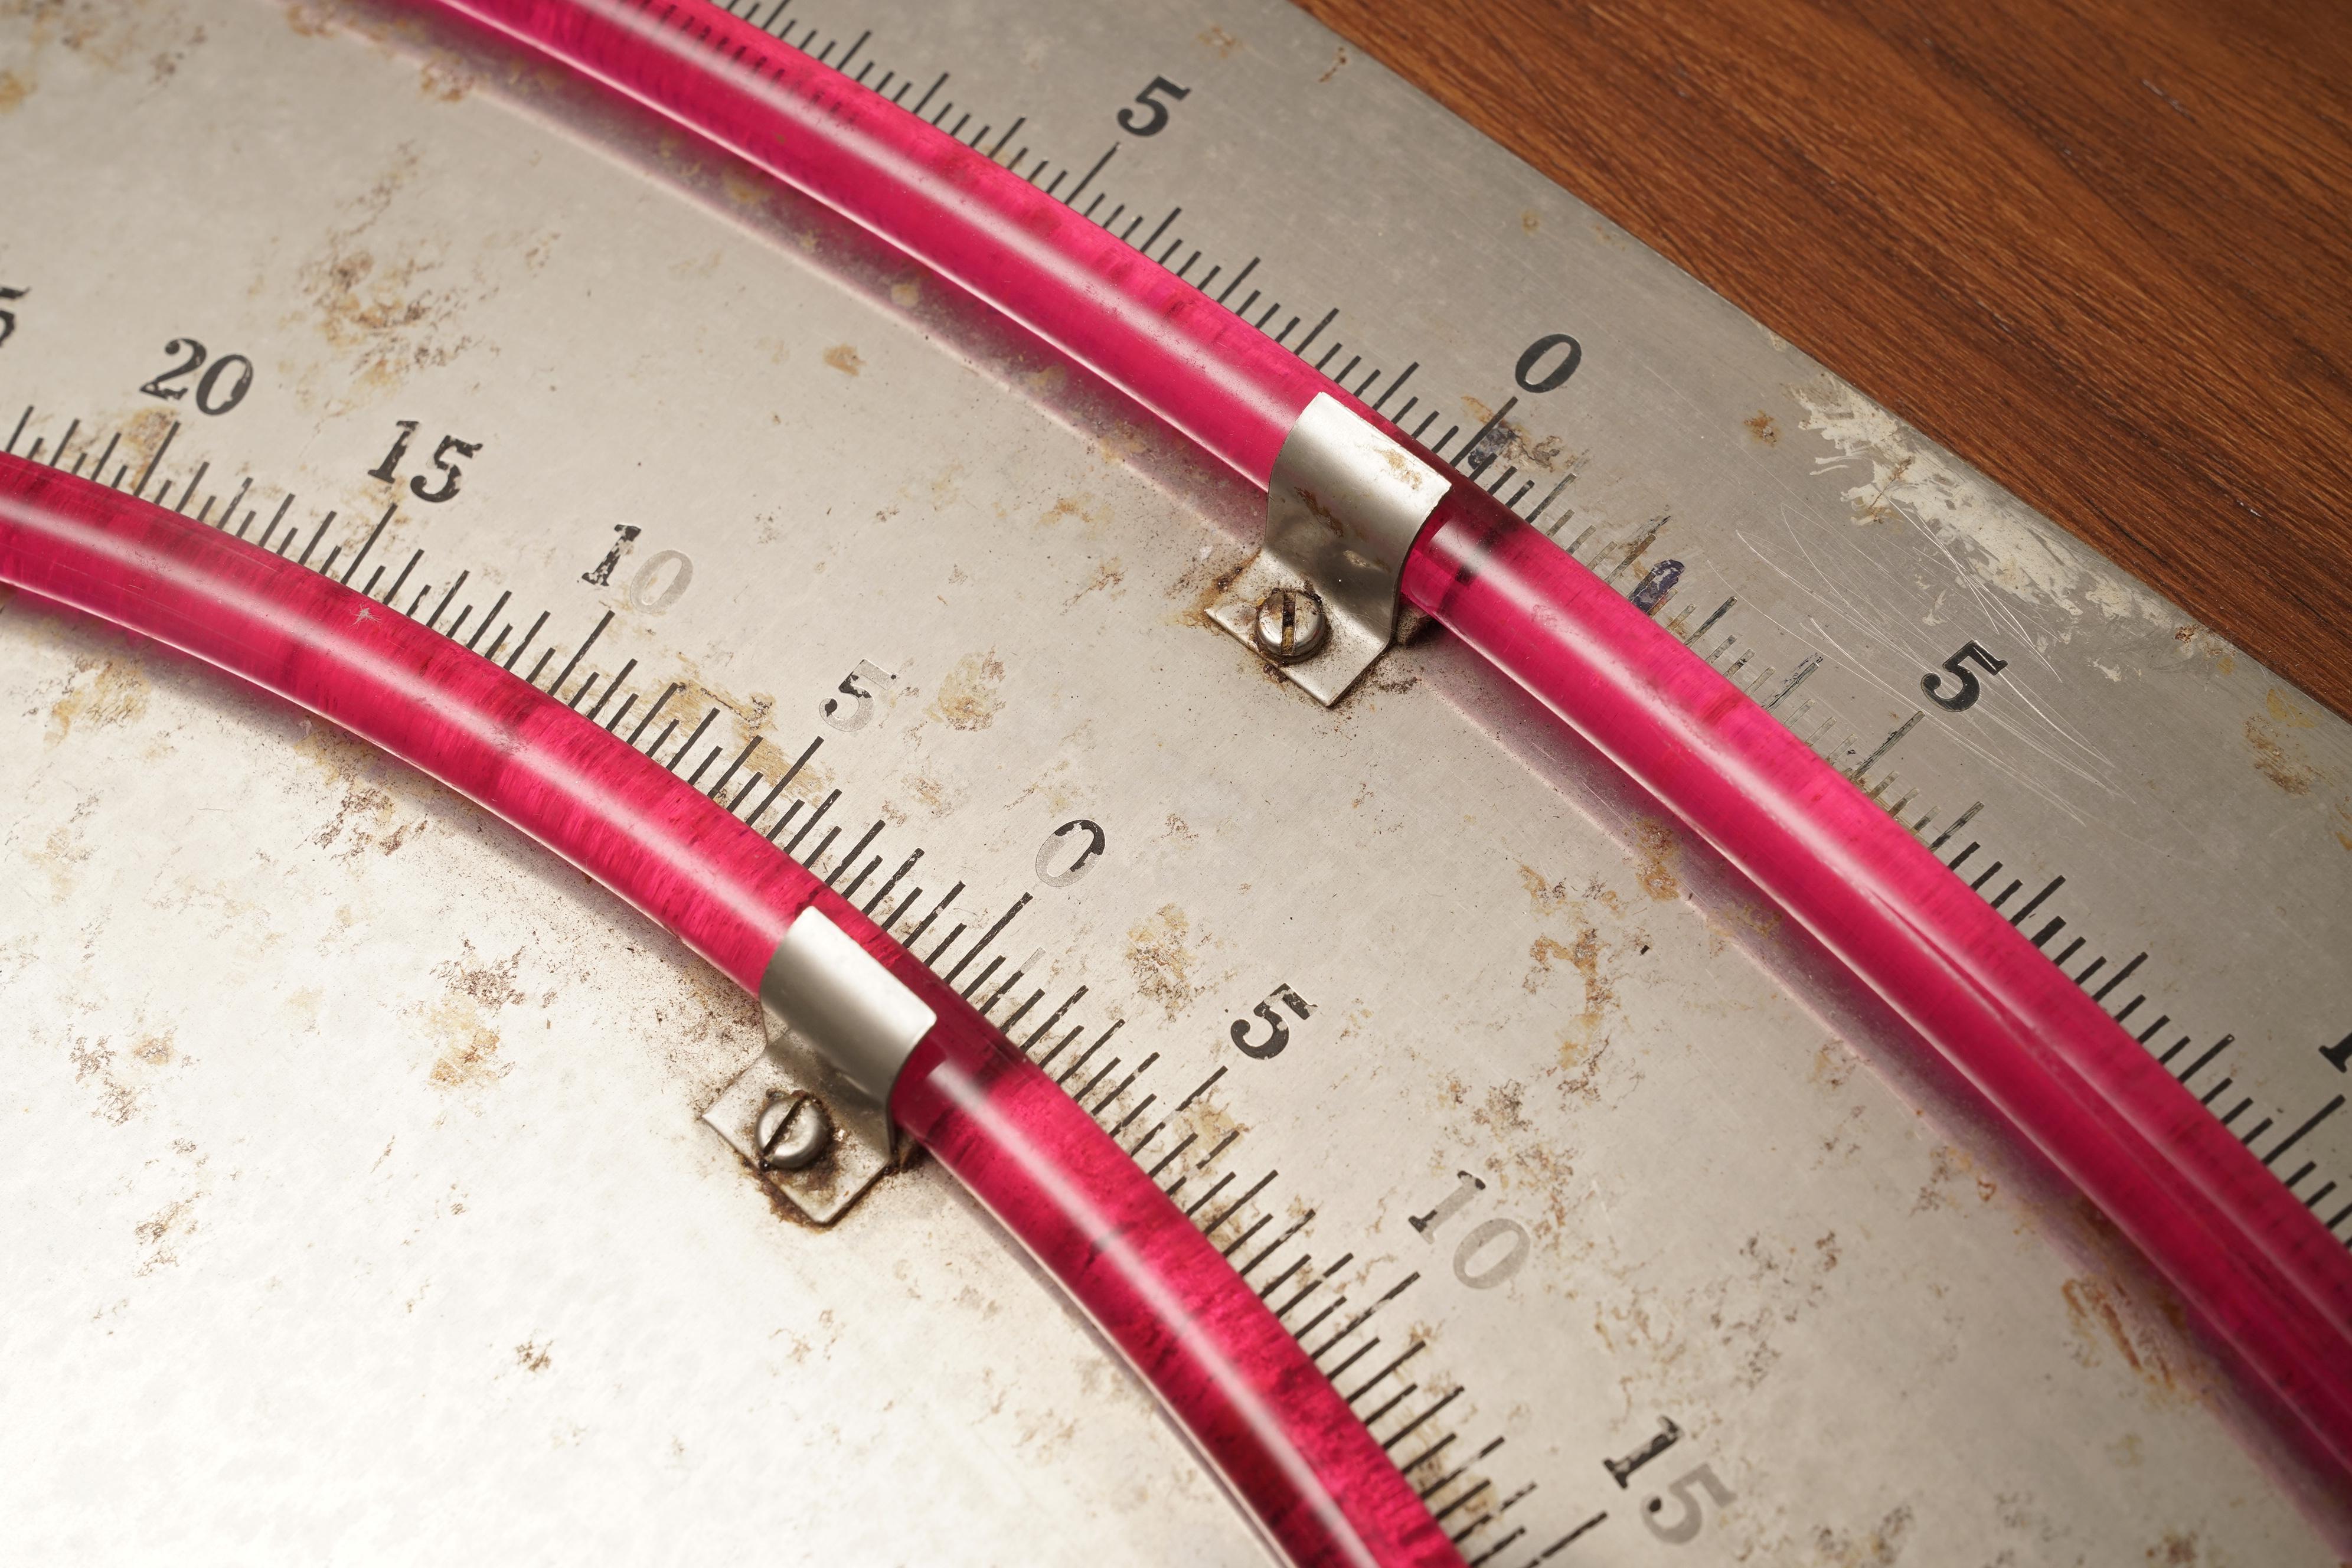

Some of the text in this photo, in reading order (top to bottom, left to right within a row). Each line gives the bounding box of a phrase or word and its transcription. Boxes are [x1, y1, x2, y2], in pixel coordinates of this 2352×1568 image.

[1118, 74, 1192, 137] 5
[140, 338, 253, 415] 20
[1515, 334, 1582, 393] 0
[368, 420, 483, 502] 15
[580, 524, 694, 615] 10
[819, 658, 899, 732] 5
[1921, 640, 2008, 713] 5
[1035, 819, 1106, 888] 0
[1231, 983, 1318, 1059] 5
[1409, 1171, 1531, 1289] 10
[1604, 1415, 1738, 1545] 15
